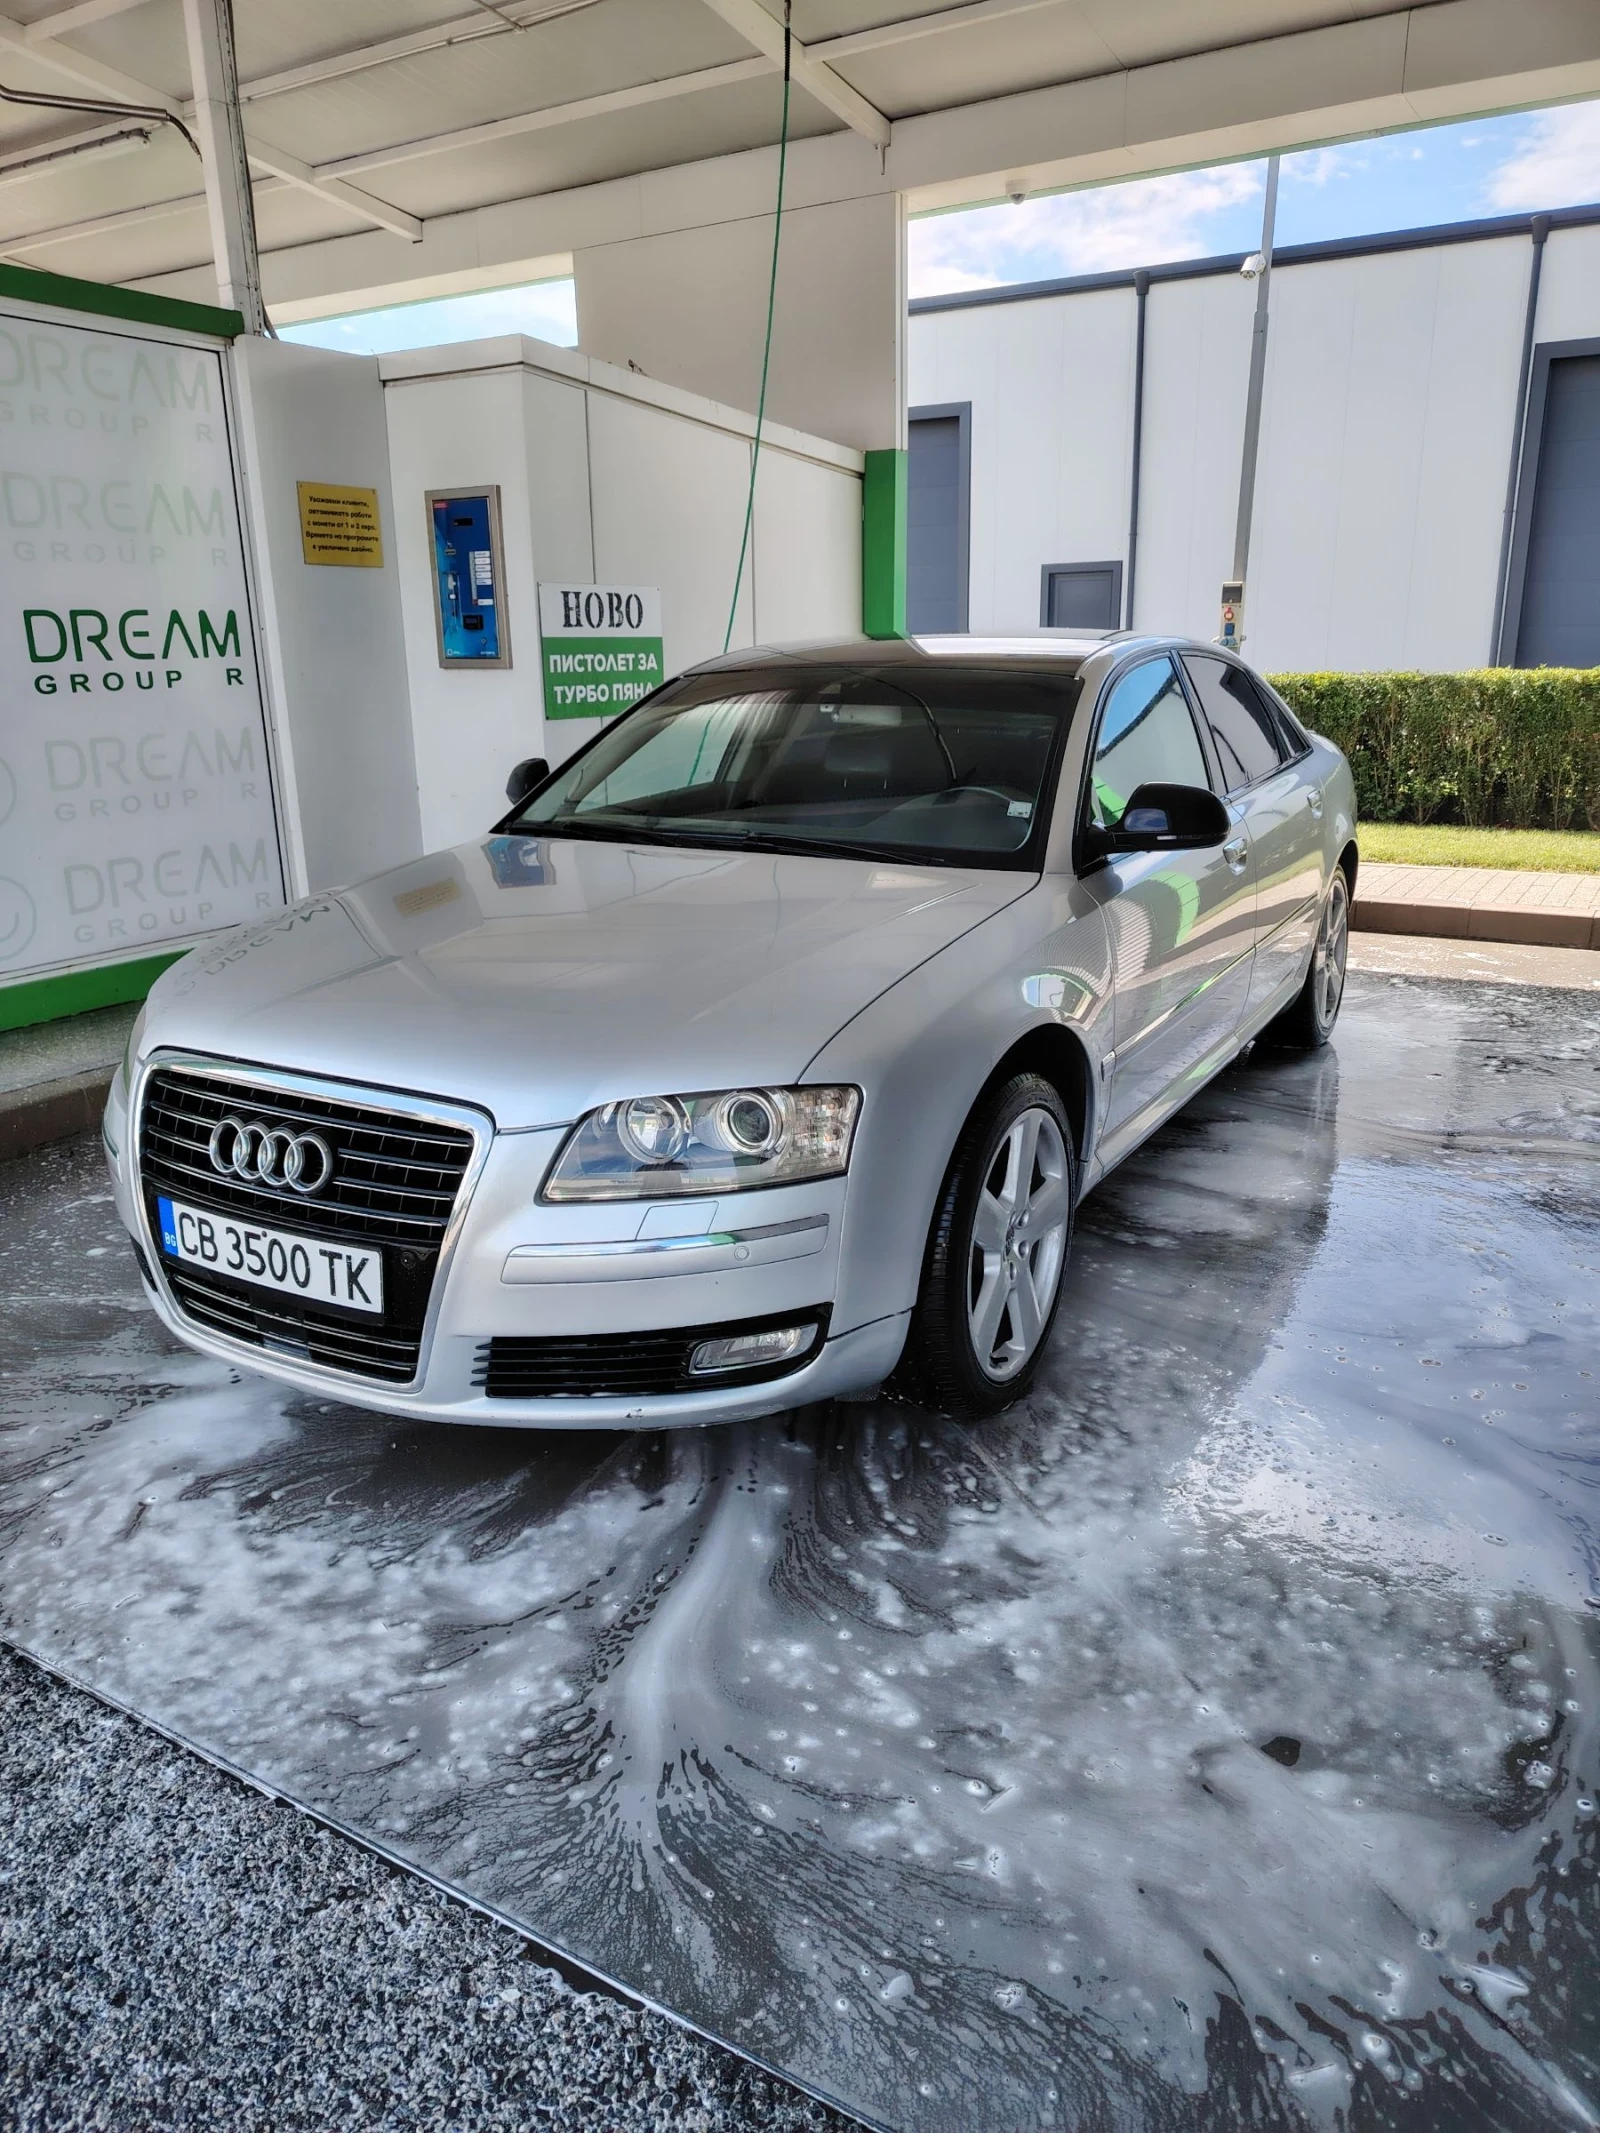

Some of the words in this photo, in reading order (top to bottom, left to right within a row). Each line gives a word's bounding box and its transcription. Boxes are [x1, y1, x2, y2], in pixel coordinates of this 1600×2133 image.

[2, 471, 226, 538] DREAM
[309, 496, 340, 504] Уважаеми
[306, 531, 333, 539] Времето
[13, 541, 165, 565] GROUP
[560, 590, 644, 629] НОВО
[23, 608, 242, 663] DREAM
[549, 653, 635, 673] ПИСТОЛЕТ
[637, 652, 658, 671] ЗА
[34, 670, 183, 695] GROUP
[226, 667, 245, 686] R
[553, 683, 610, 705] ТУРБО
[44, 726, 256, 792] DREAM
[55, 788, 199, 822] GROUP
[64, 837, 270, 916] DREAM
[73, 902, 214, 943] GROUP
[164, 1231, 177, 1247] BG
[178, 1211, 219, 1263] CB
[225, 1226, 311, 1289] 3500
[318, 1248, 373, 1305] TK
